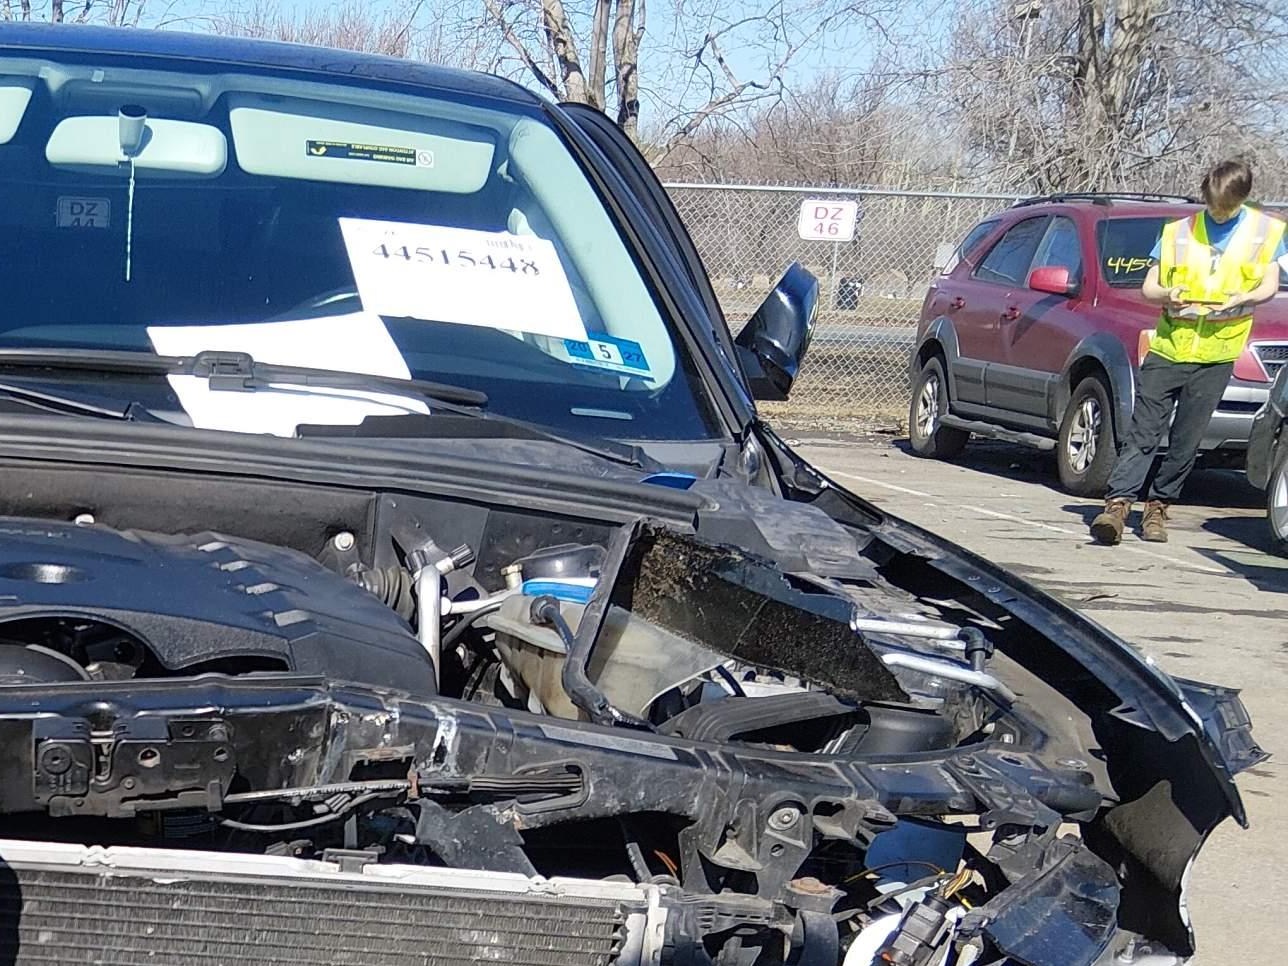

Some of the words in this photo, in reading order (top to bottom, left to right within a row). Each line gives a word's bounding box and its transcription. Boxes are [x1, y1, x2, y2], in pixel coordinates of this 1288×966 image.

[70, 202, 98, 216] DZ
[814, 206, 844, 220] DZ
[814, 222, 840, 236] 46
[372, 243, 540, 276] 44515448
[597, 343, 612, 360] 5
[623, 351, 642, 363] 27
